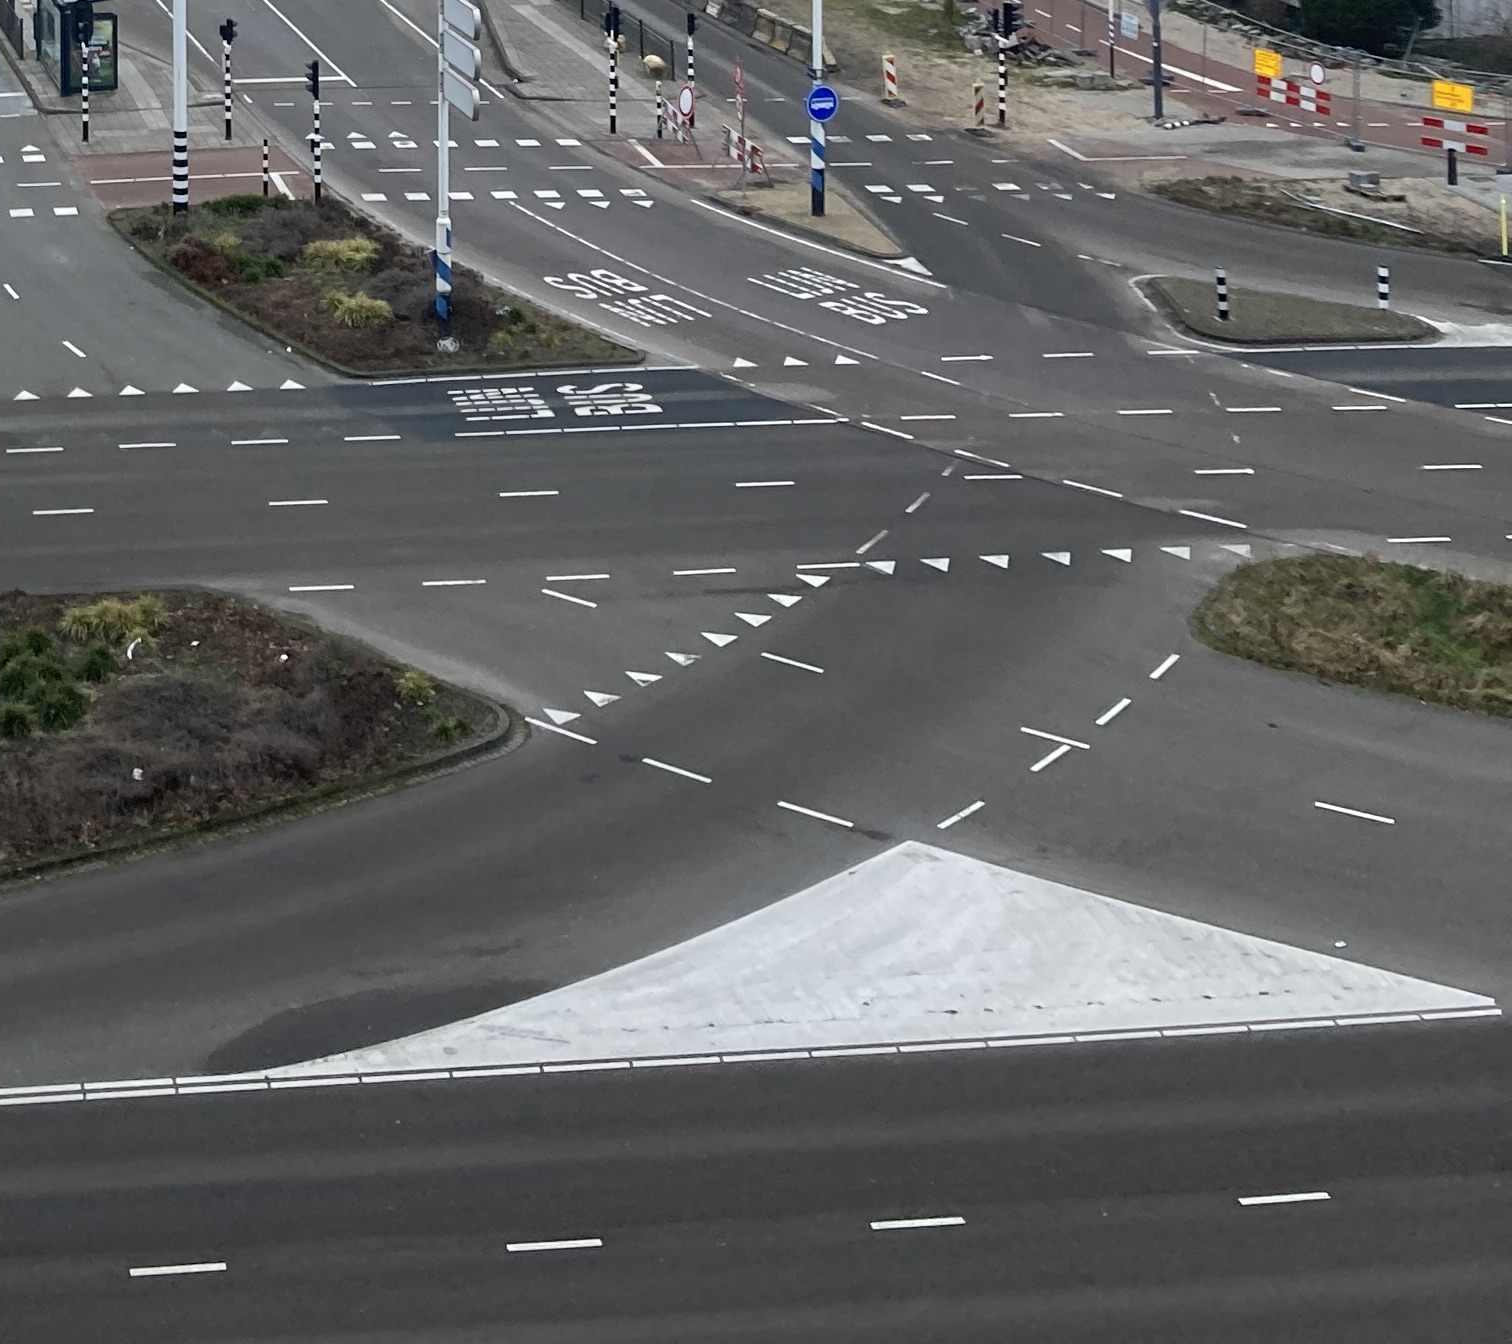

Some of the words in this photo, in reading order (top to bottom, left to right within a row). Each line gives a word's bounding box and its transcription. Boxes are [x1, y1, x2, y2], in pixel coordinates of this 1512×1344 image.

[543, 268, 649, 299] BUS
[747, 266, 861, 299] LIJN
[598, 294, 712, 327] LIJN
[818, 292, 929, 325] BUS
[447, 387, 556, 421] LIJN
[556, 383, 663, 417] BUS
